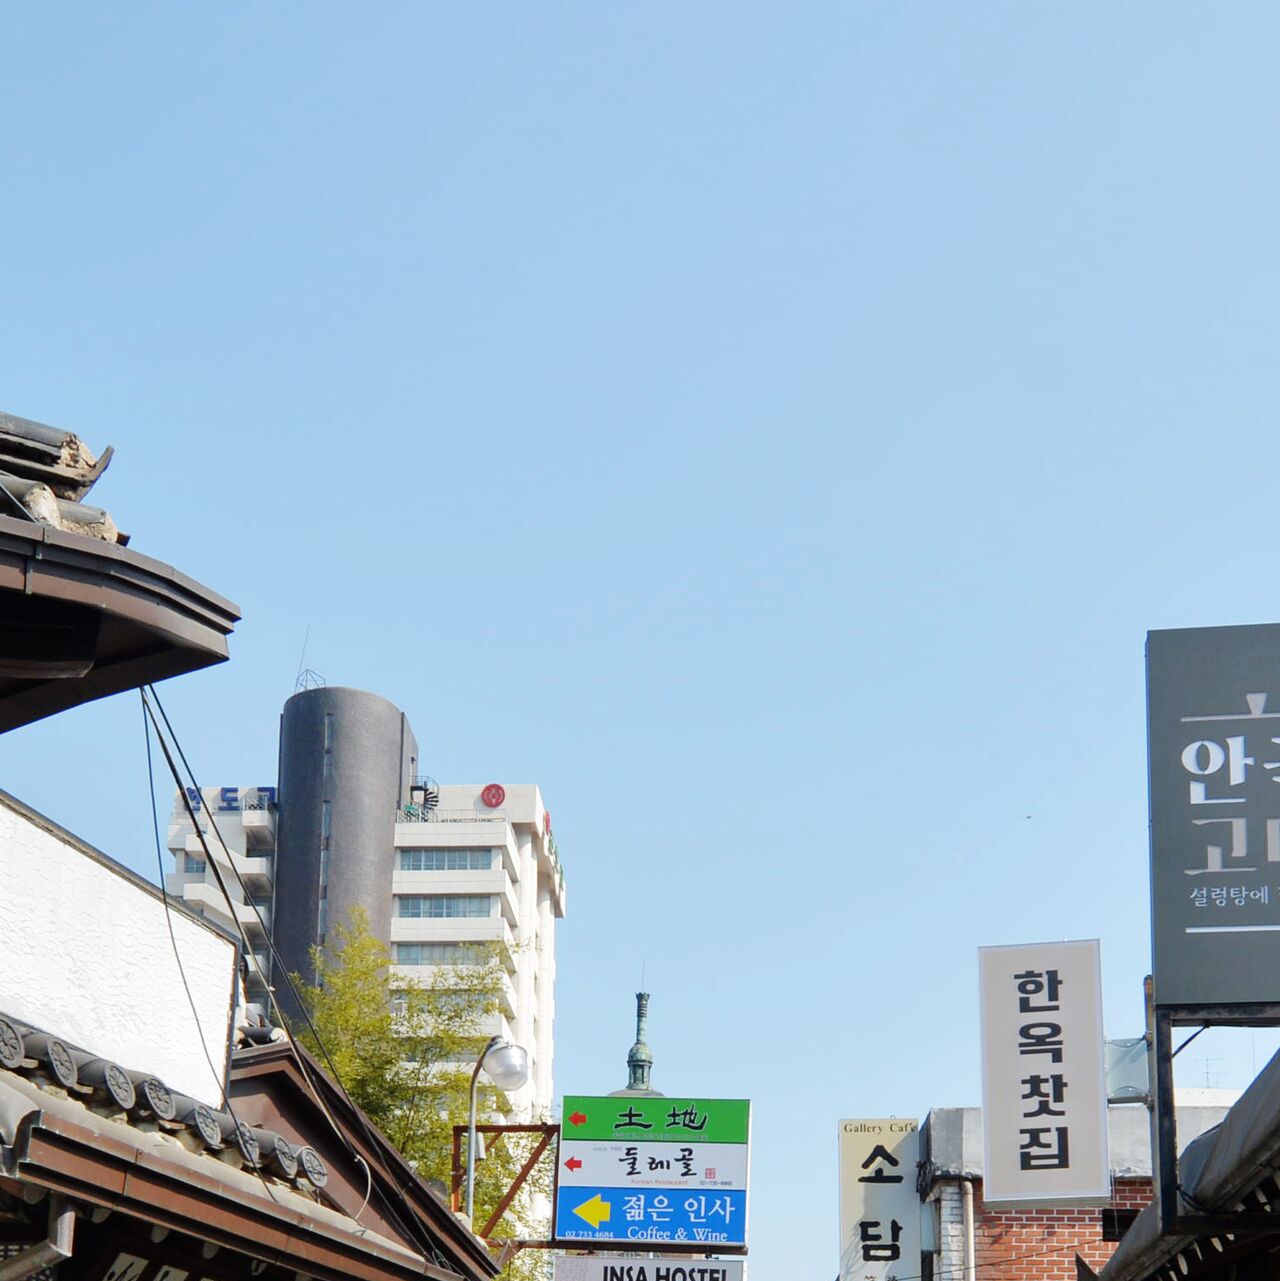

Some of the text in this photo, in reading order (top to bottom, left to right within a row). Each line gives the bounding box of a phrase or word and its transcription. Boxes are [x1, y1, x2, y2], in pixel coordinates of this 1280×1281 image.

[1189, 883, 1269, 908] 설렁탕에
[1013, 968, 1070, 1171] 한옥찻집
[614, 1103, 707, 1130] 土地
[844, 1123, 883, 1134] Gallery
[622, 1193, 736, 1224] 젊은 인사
[858, 1144, 904, 1262] 소담
[627, 1226, 728, 1242] Coffee & Wine
